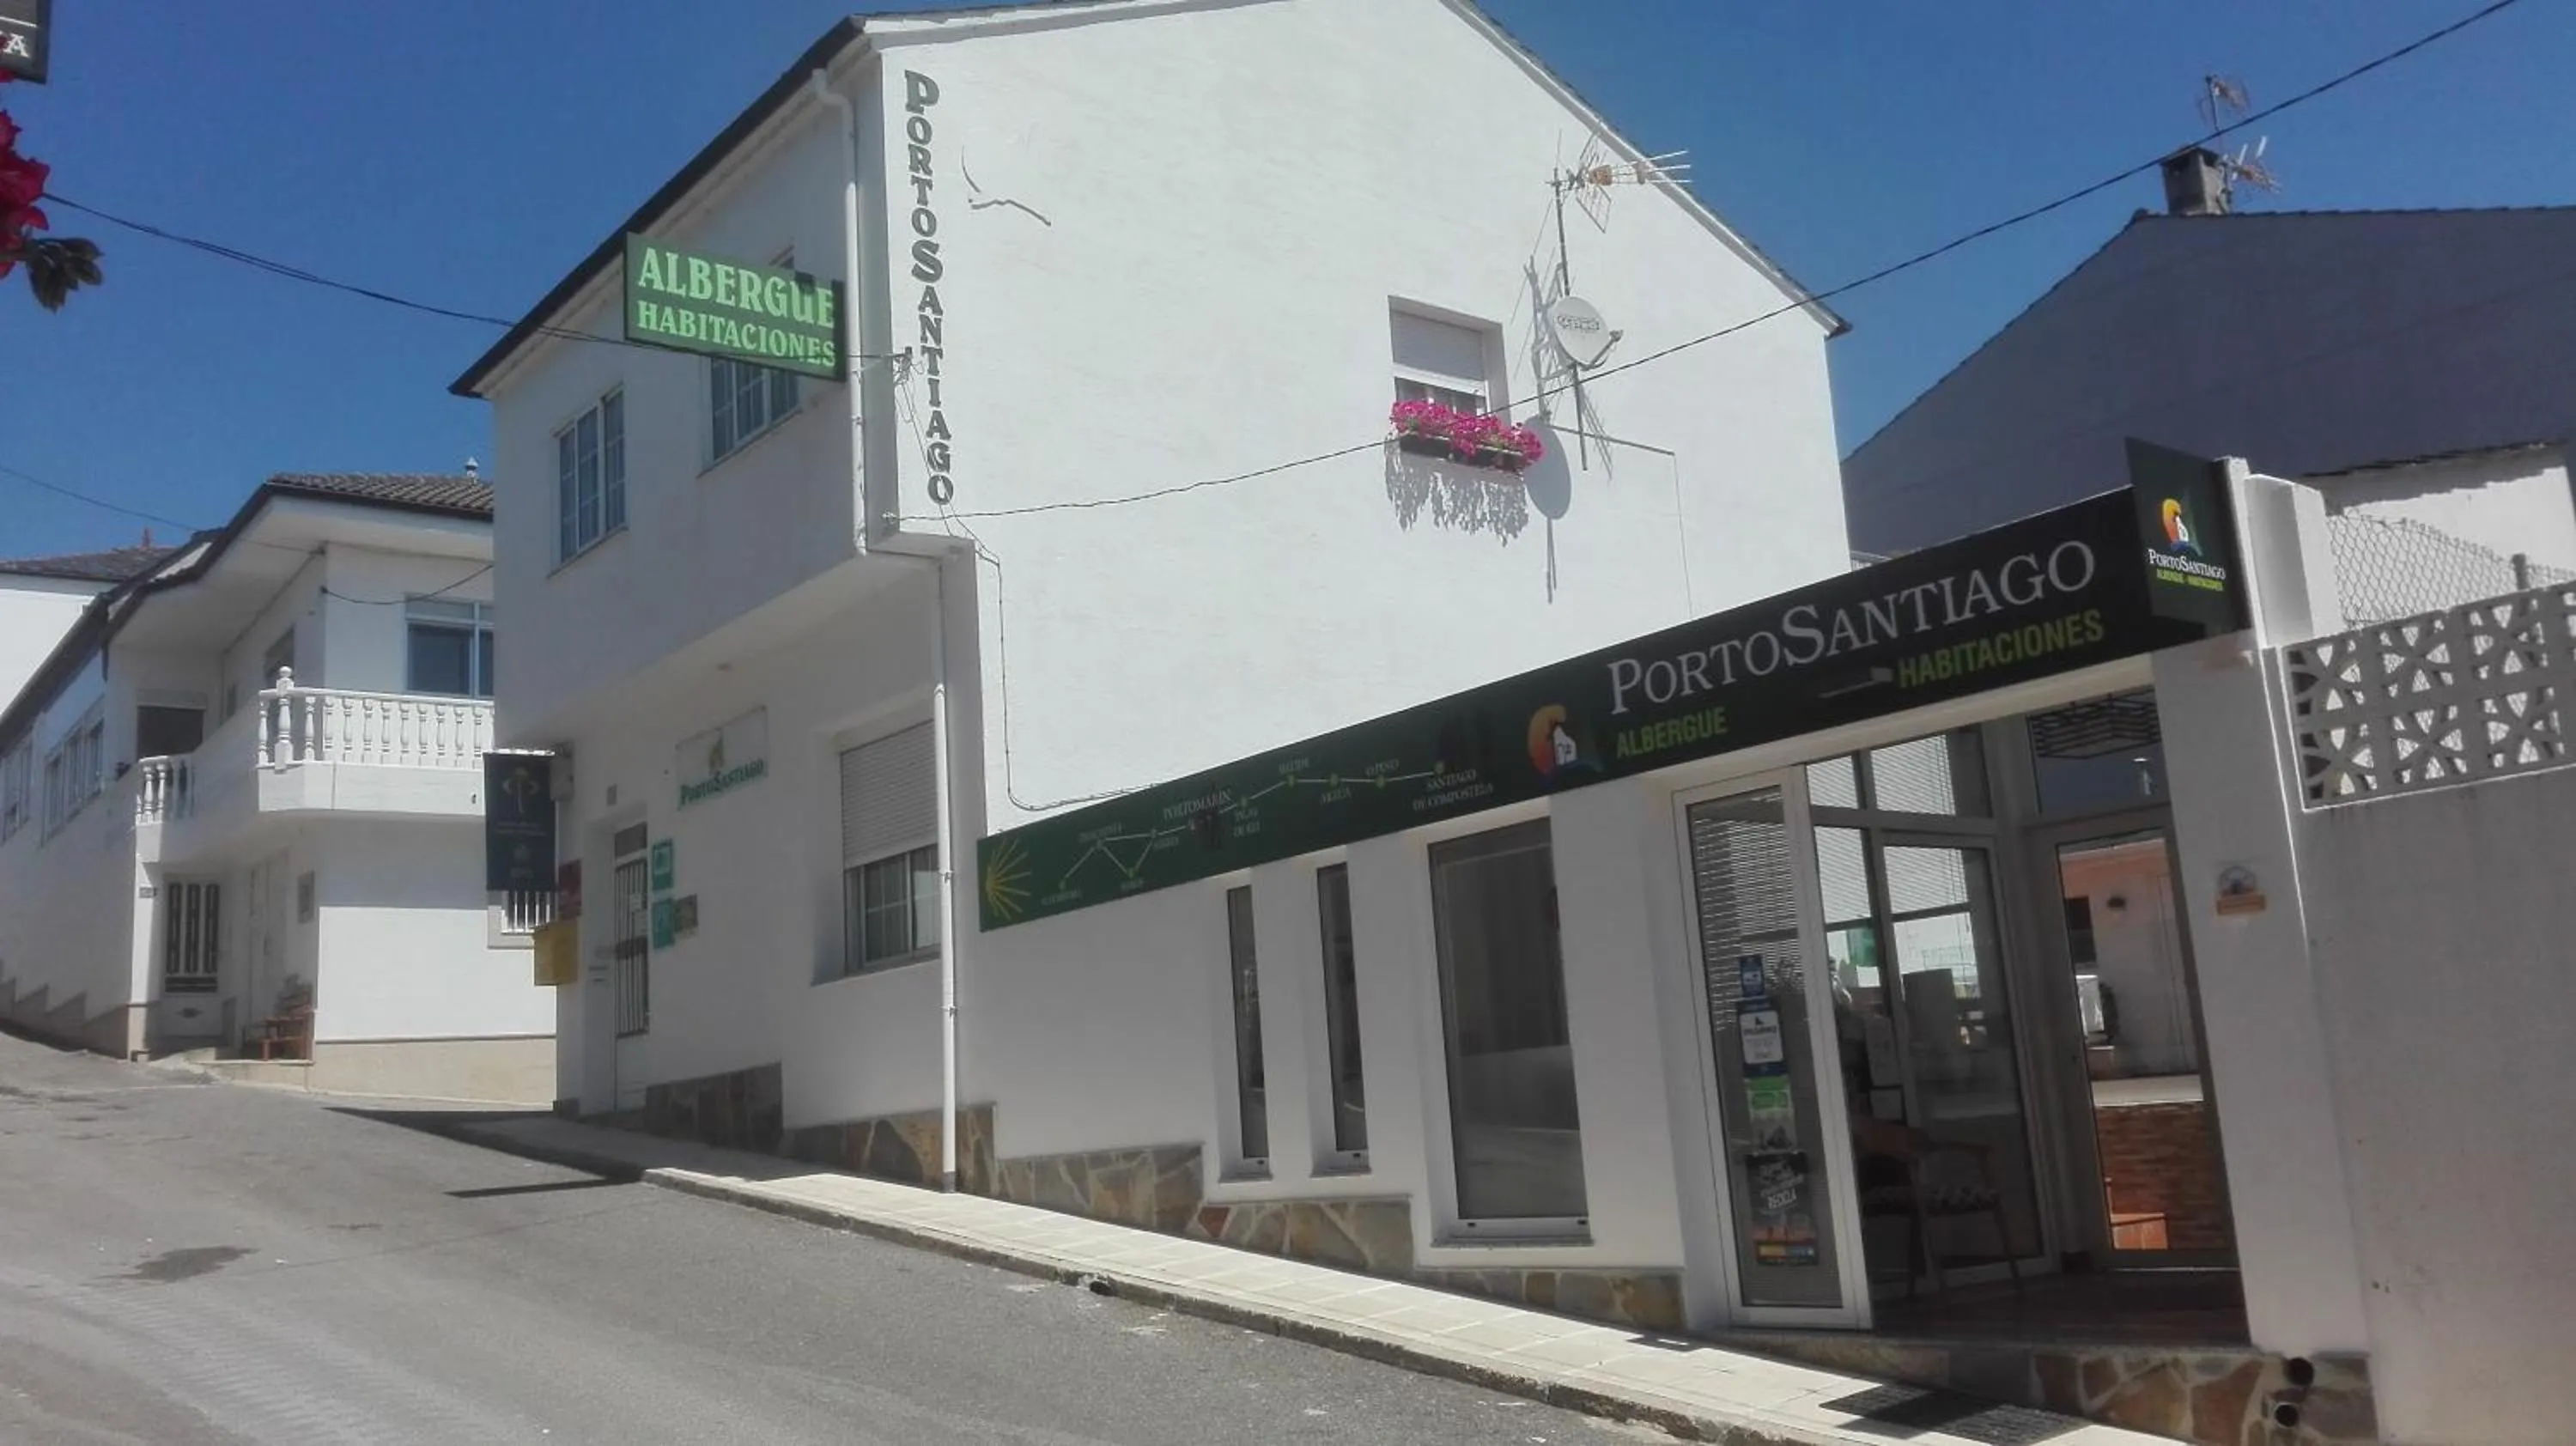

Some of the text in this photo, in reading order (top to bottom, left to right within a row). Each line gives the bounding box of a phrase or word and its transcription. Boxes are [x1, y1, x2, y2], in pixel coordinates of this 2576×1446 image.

[638, 246, 835, 329] ALBERGUE
[904, 69, 954, 506] PORTOSANTIAGO
[637, 300, 836, 368] HABITACIONES
[2148, 548, 2226, 580] PORTOSANTIAGO
[1607, 540, 2095, 715] PORTOSANTIAGO
[1899, 609, 2105, 688] HABITACIONES
[1616, 706, 1728, 759] ALBERGUE
